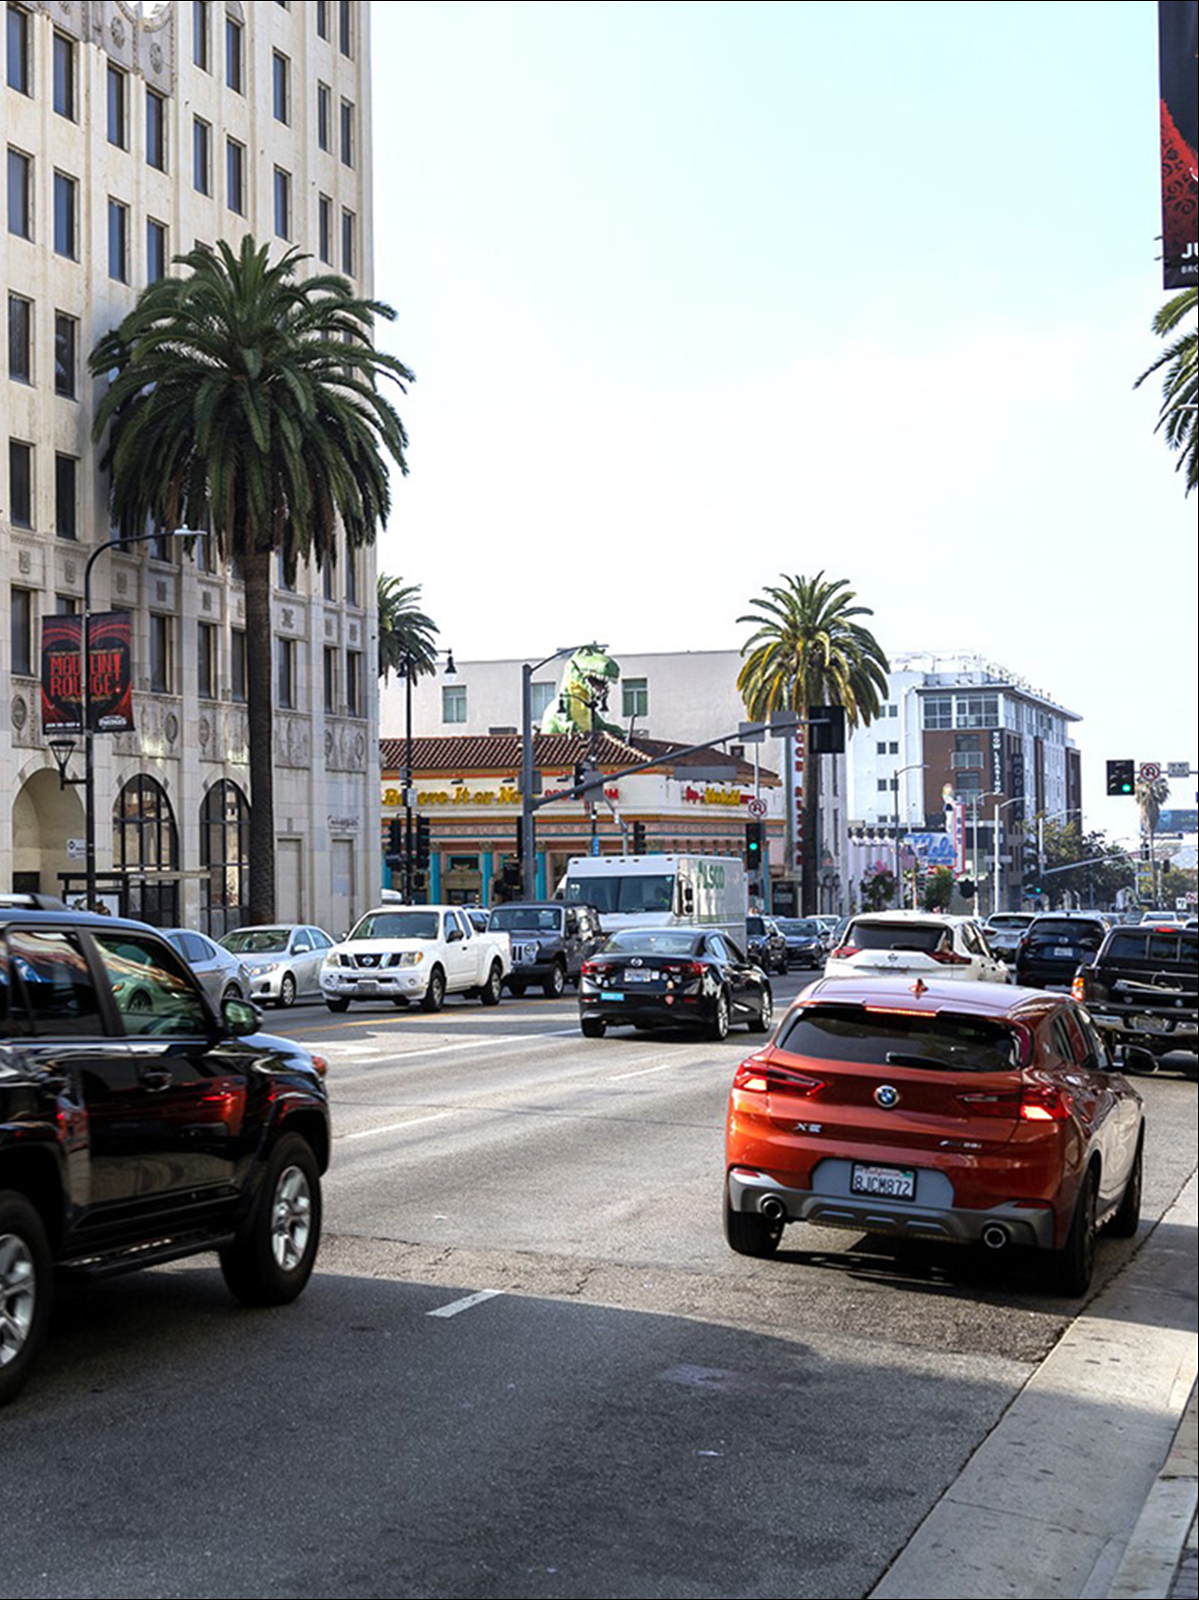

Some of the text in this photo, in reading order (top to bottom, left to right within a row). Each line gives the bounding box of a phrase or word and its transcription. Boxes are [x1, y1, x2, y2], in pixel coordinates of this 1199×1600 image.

[992, 731, 1001, 795] NOW LEASING
[382, 788, 449, 806] Beve
[453, 786, 471, 805] It
[473, 791, 495, 805] or
[497, 786, 523, 805] No
